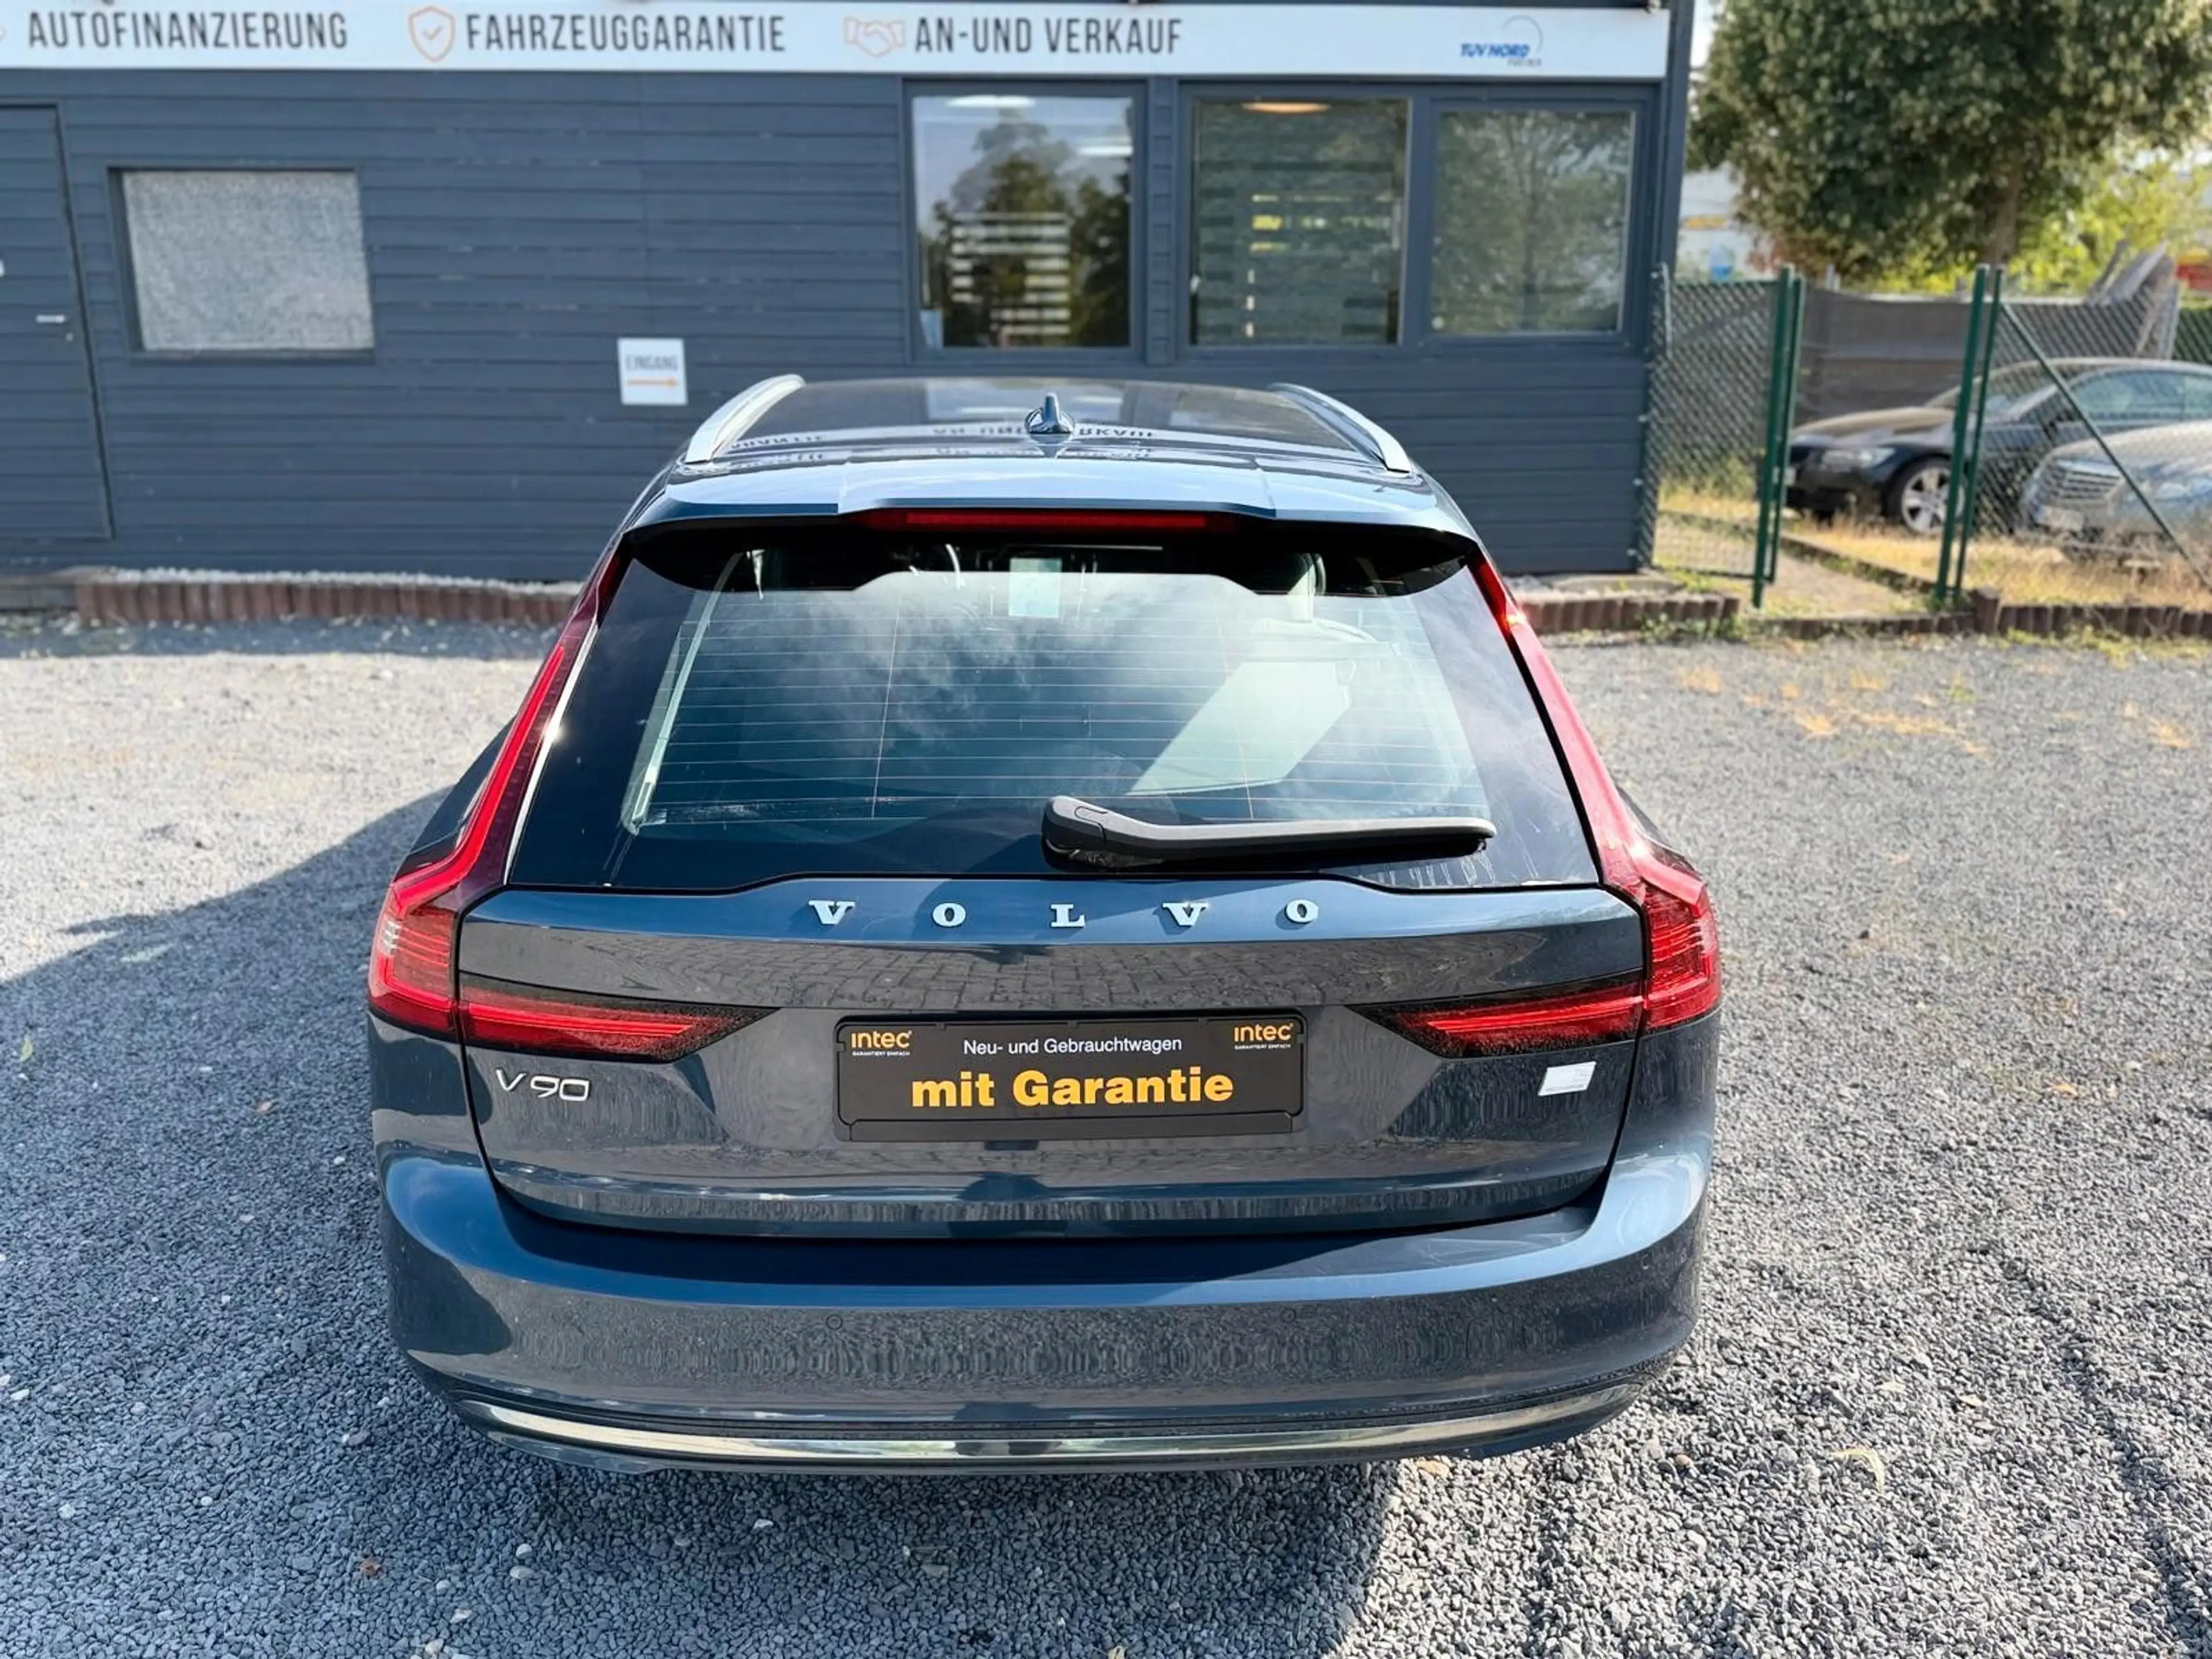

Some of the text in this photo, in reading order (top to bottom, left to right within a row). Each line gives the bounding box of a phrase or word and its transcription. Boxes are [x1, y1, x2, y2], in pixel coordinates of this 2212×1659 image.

[29, 12, 347, 48] AUTOFINANZIERUNG
[466, 14, 786, 52] FAHRZEUGGARANTIE
[915, 17, 1183, 54] AN-UND VERKAUF
[808, 899, 1319, 927] VOLVO
[851, 1030, 912, 1049] intec
[964, 1037, 1182, 1055] Neu- und Gebrauchtwagen
[1234, 1024, 1293, 1042] intec
[912, 1066, 1233, 1107] mit Garantie
